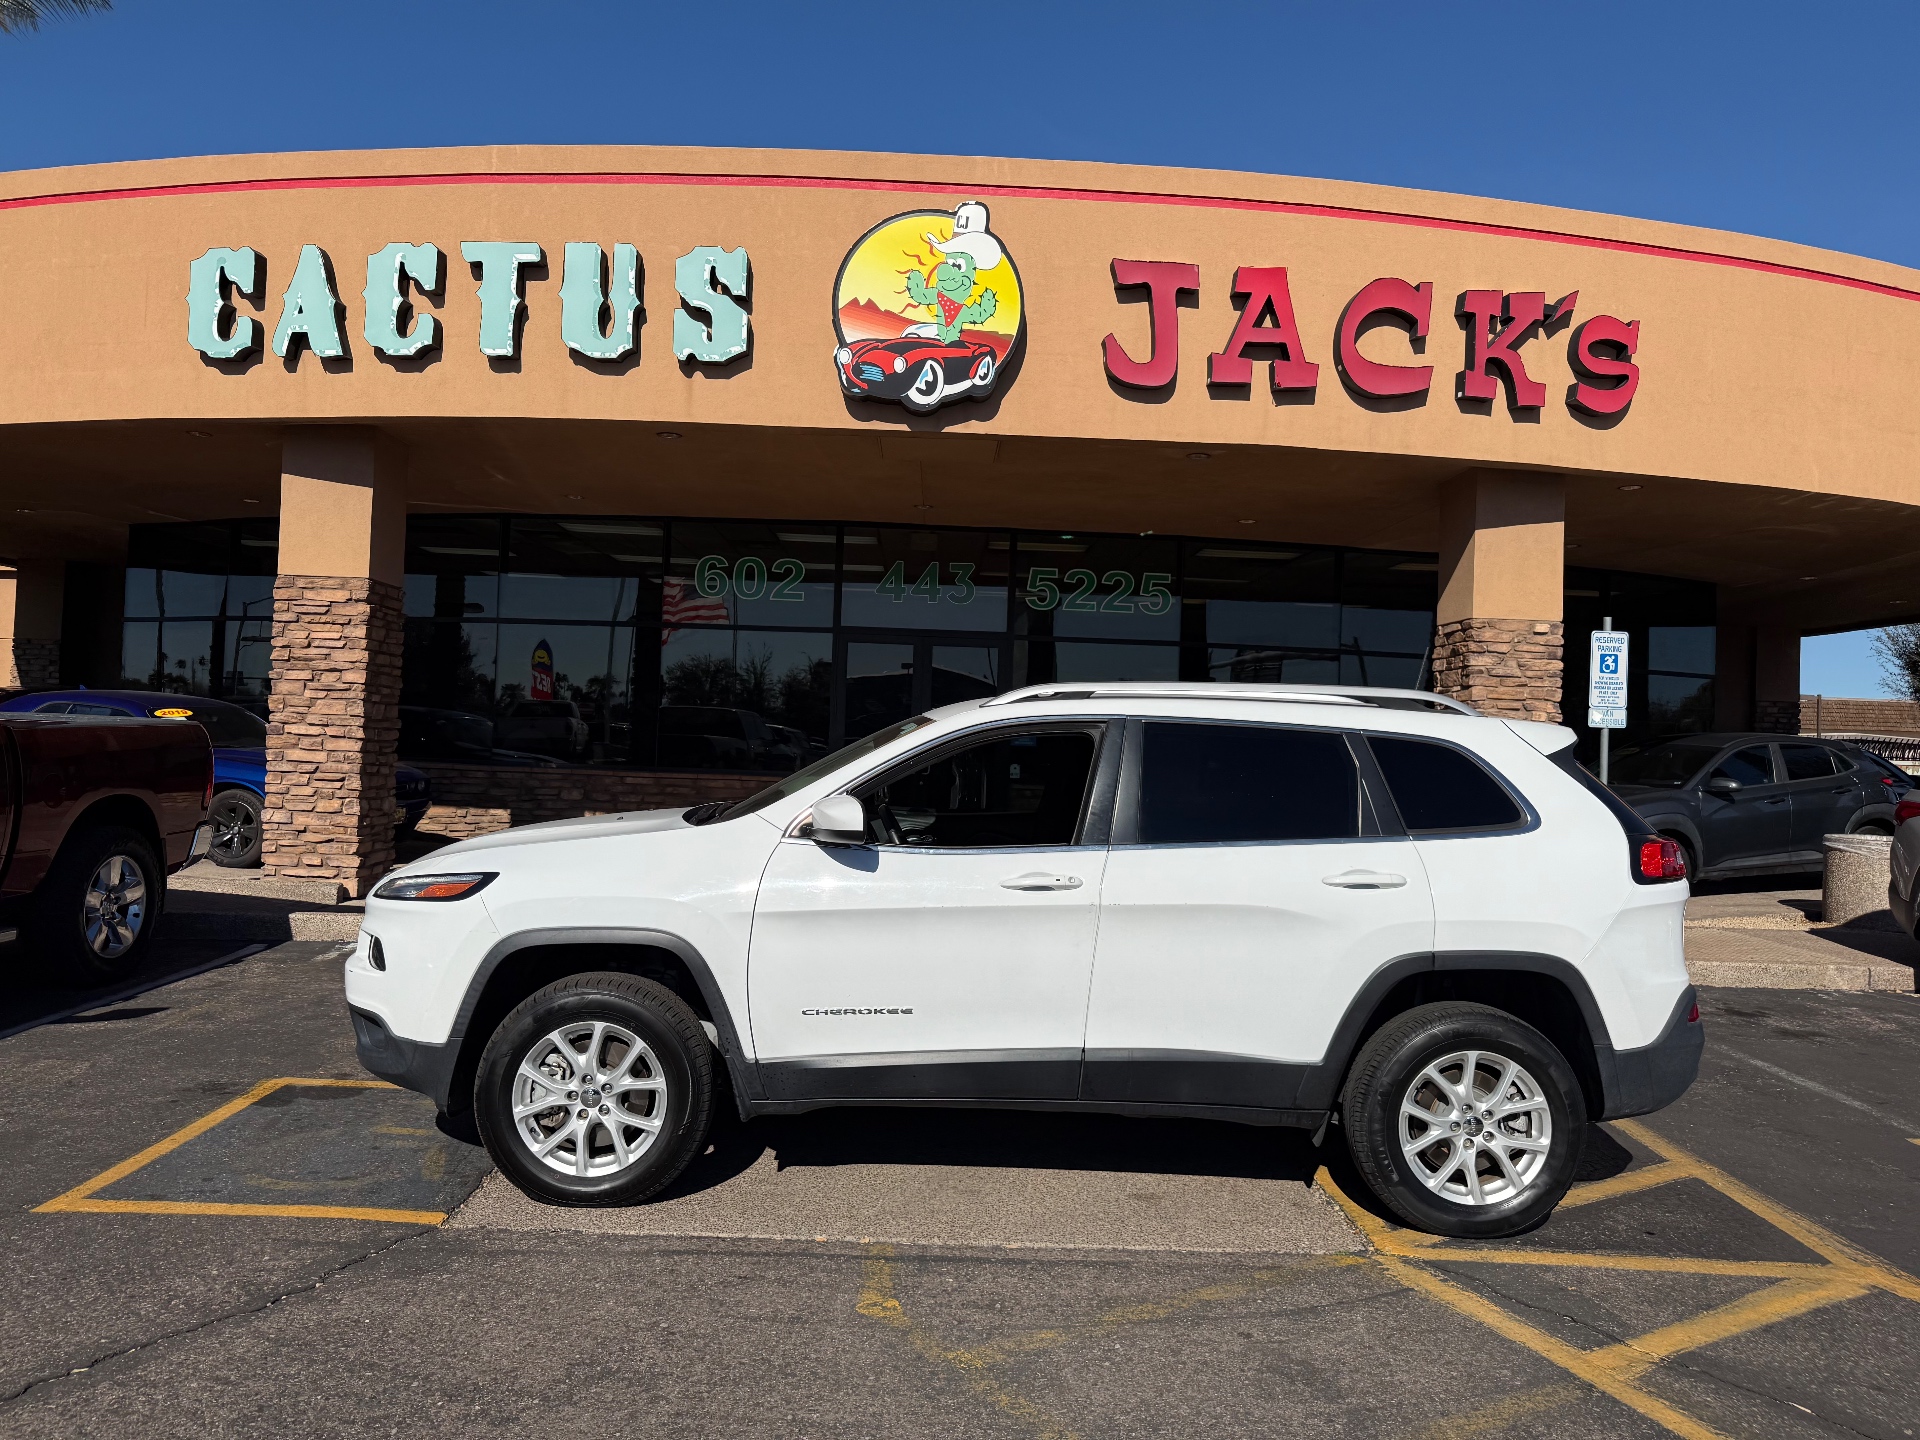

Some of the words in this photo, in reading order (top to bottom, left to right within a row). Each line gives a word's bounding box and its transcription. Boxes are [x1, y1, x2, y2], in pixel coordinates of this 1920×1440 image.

[956, 214, 970, 229] CJ
[185, 242, 750, 361] CACTUS
[695, 555, 805, 601] 602
[875, 560, 976, 605] 443
[1025, 567, 1172, 615] 5225
[1595, 636, 1625, 644] RESERVED
[801, 1008, 914, 1016] CHEROKEE
